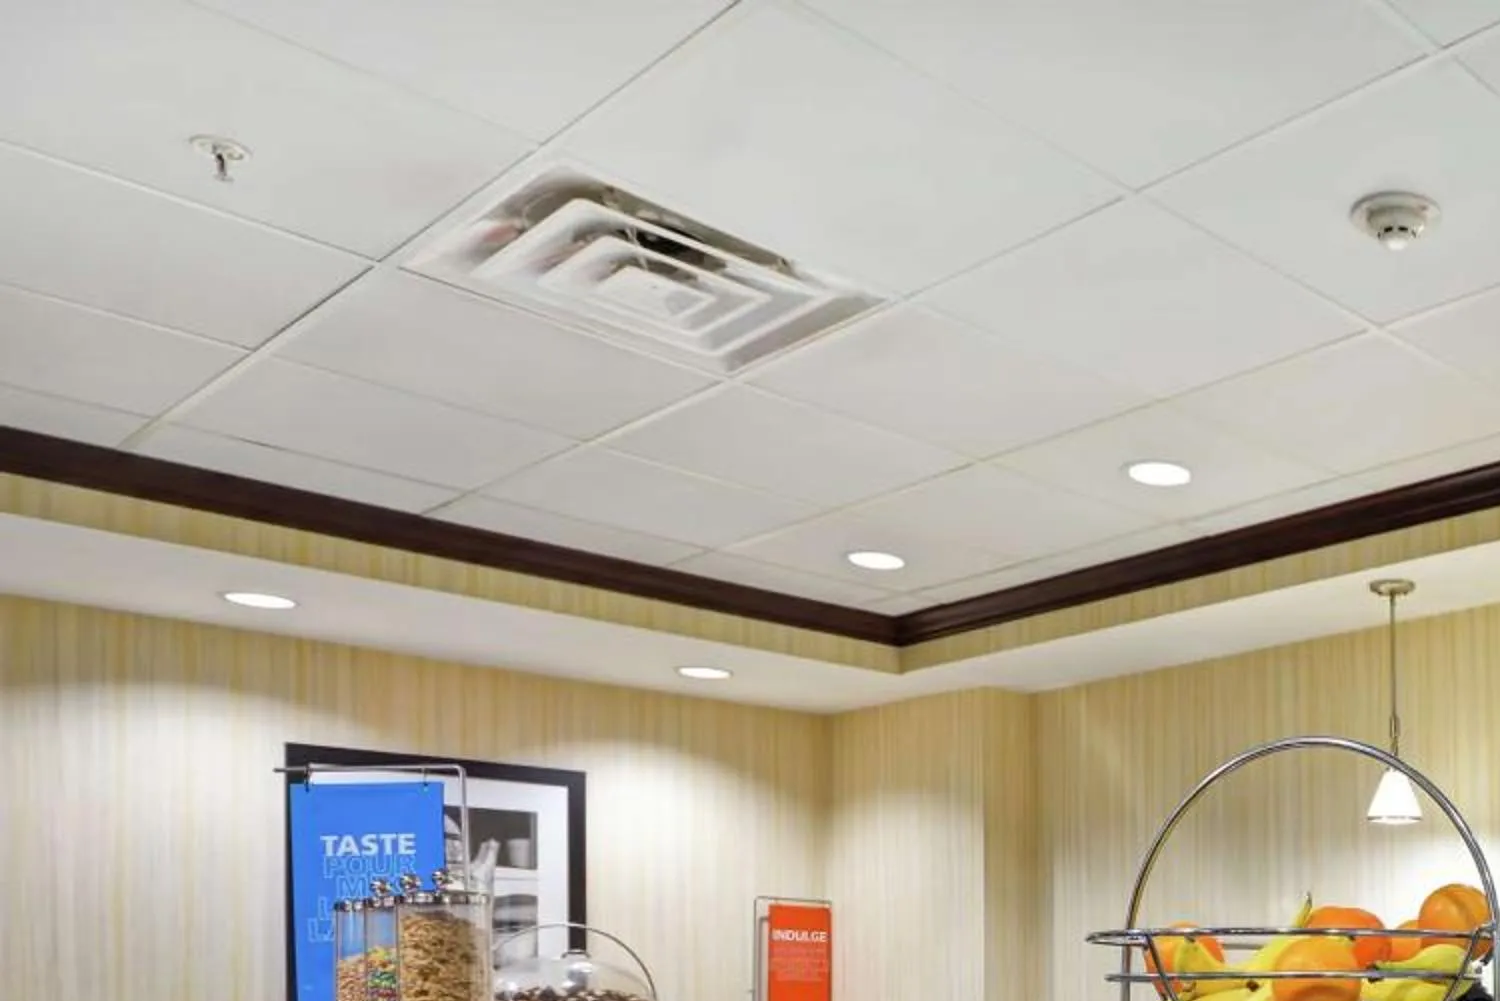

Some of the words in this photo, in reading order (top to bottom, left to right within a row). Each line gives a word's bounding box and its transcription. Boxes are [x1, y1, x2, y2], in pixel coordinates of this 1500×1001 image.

[319, 833, 417, 857] TASTE
[323, 853, 417, 879] POUR
[771, 929, 828, 943] INDULGE
